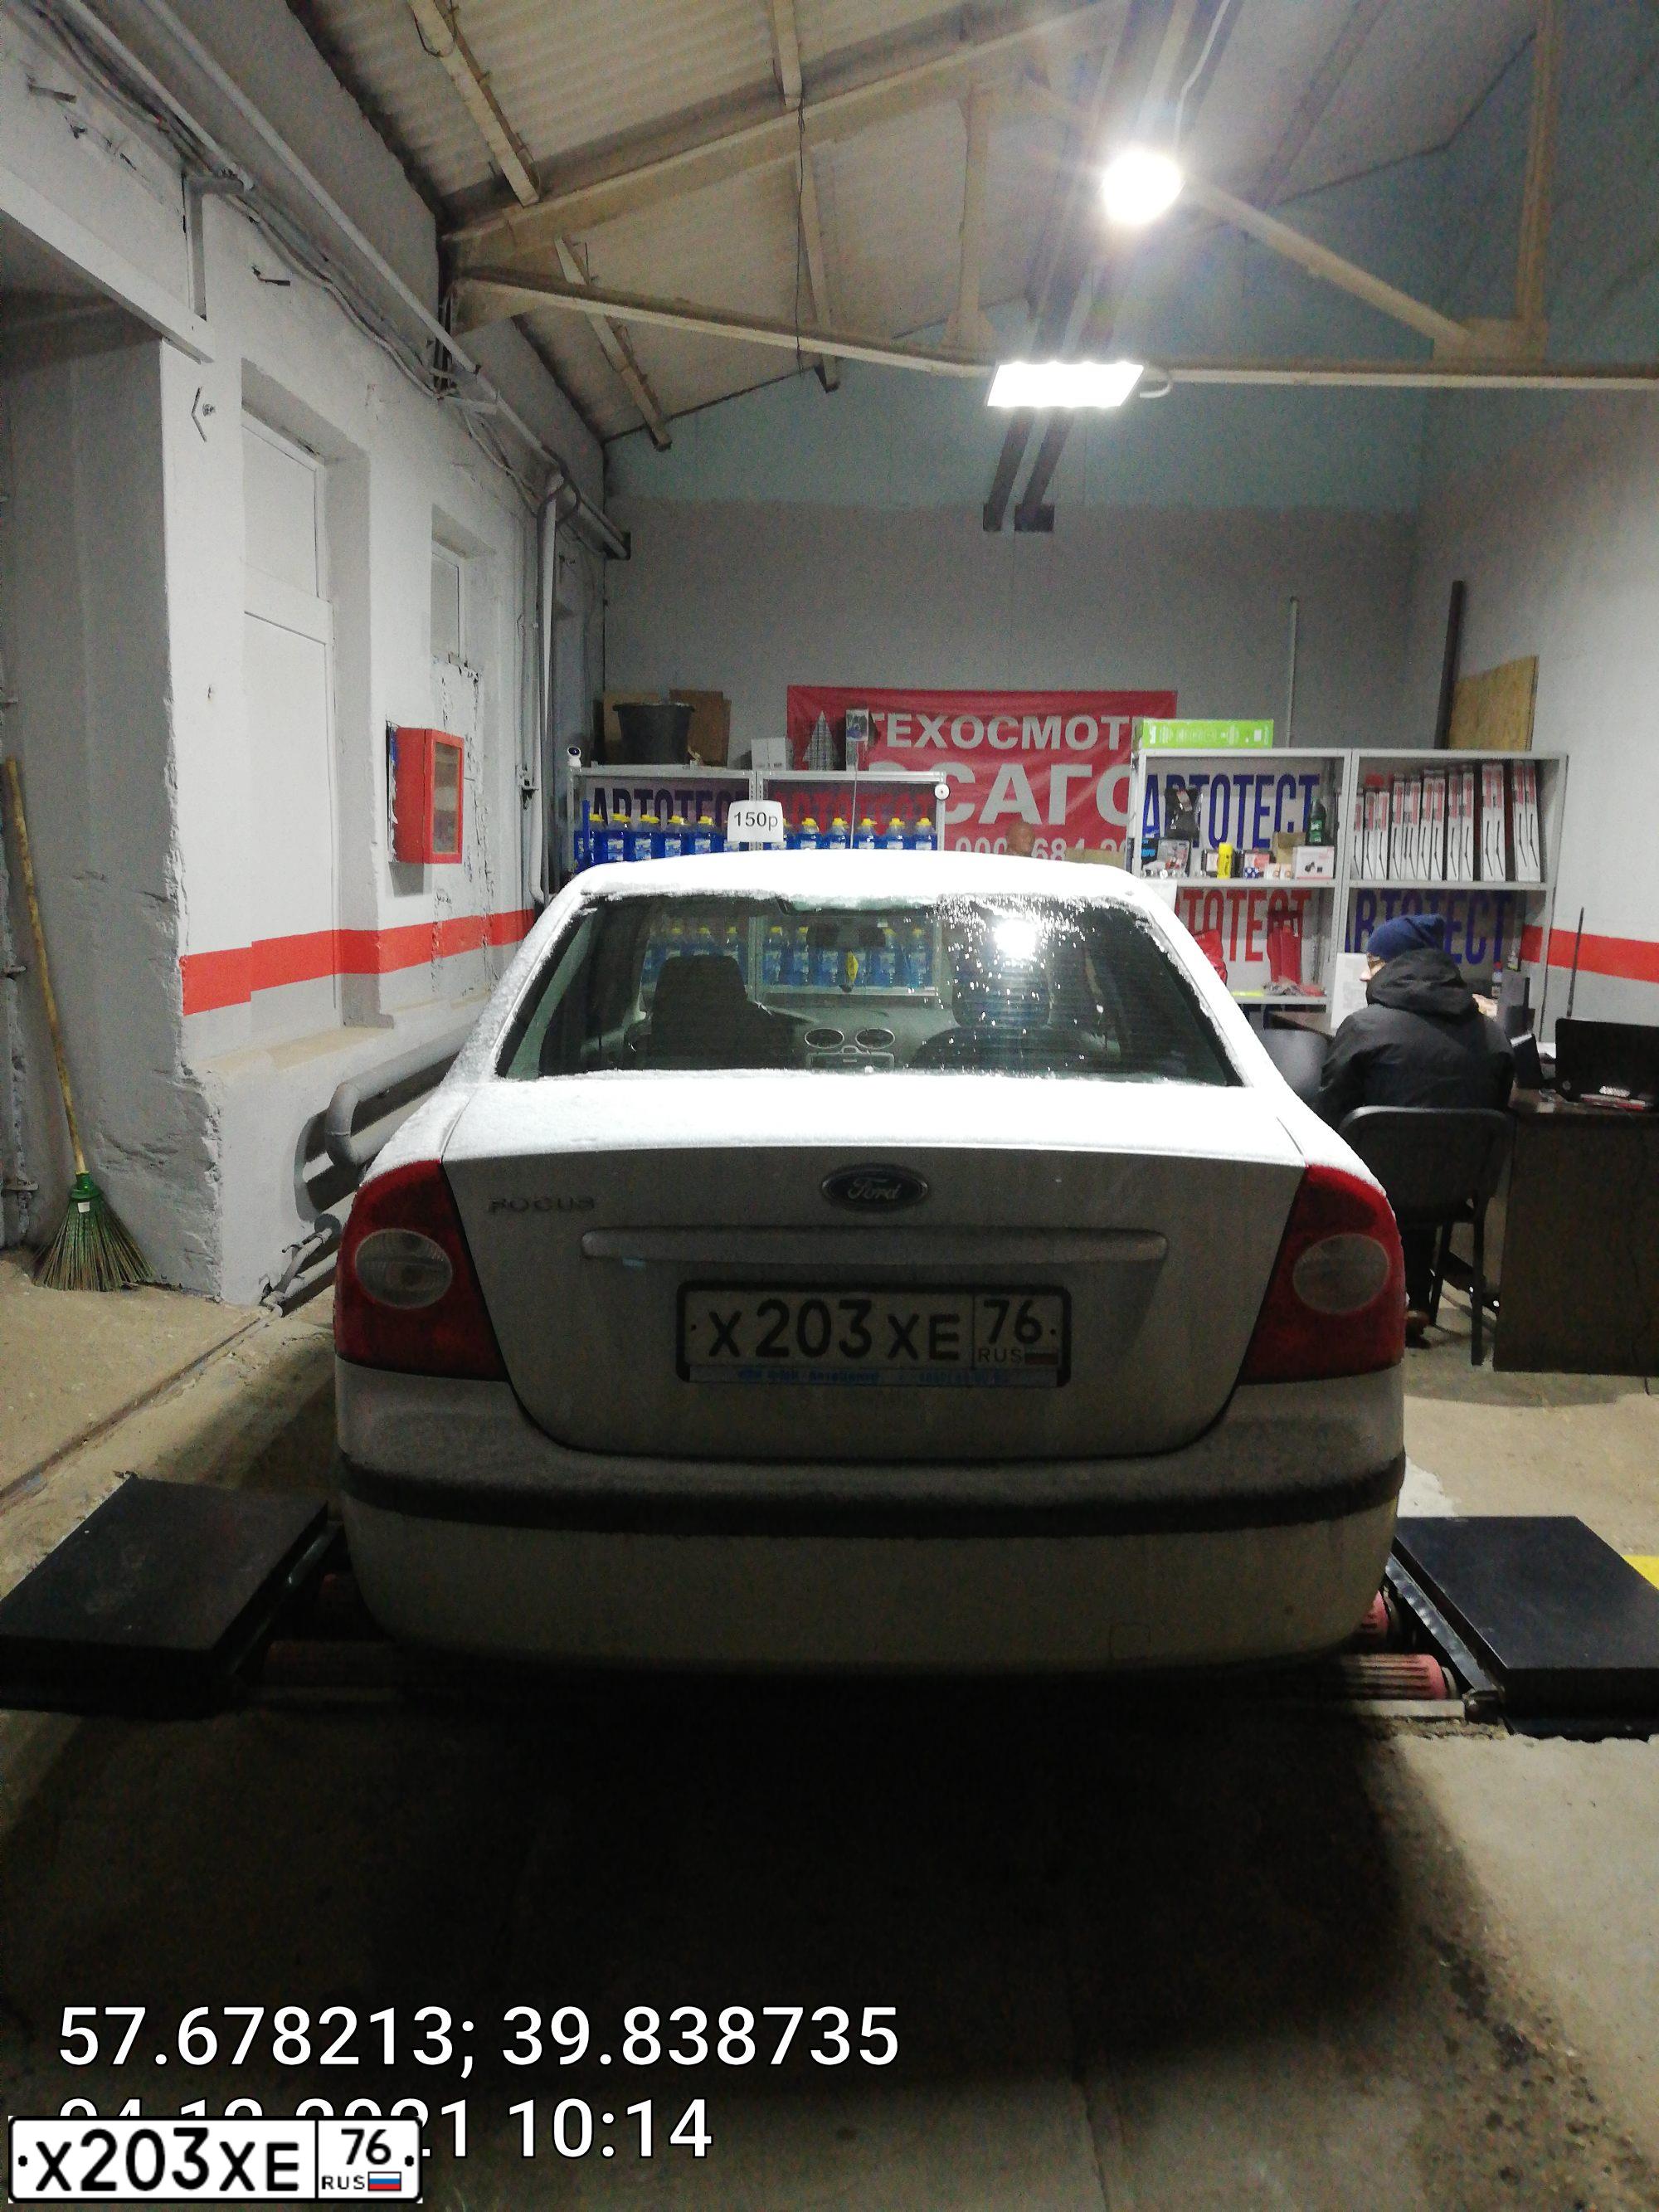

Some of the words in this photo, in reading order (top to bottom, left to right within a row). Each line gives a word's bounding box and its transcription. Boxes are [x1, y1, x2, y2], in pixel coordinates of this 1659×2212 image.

[872, 712, 1143, 751] ЕХОСМОТ
[593, 787, 750, 828] АТОТ
[868, 762, 1131, 826] САГО
[733, 811, 778, 831] 150р
[1345, 889, 1513, 965] ВТЕСТ
[848, 1177, 902, 1200] Ford
[984, 1299, 1042, 1344] 76
[979, 1348, 1023, 1363] RUS
